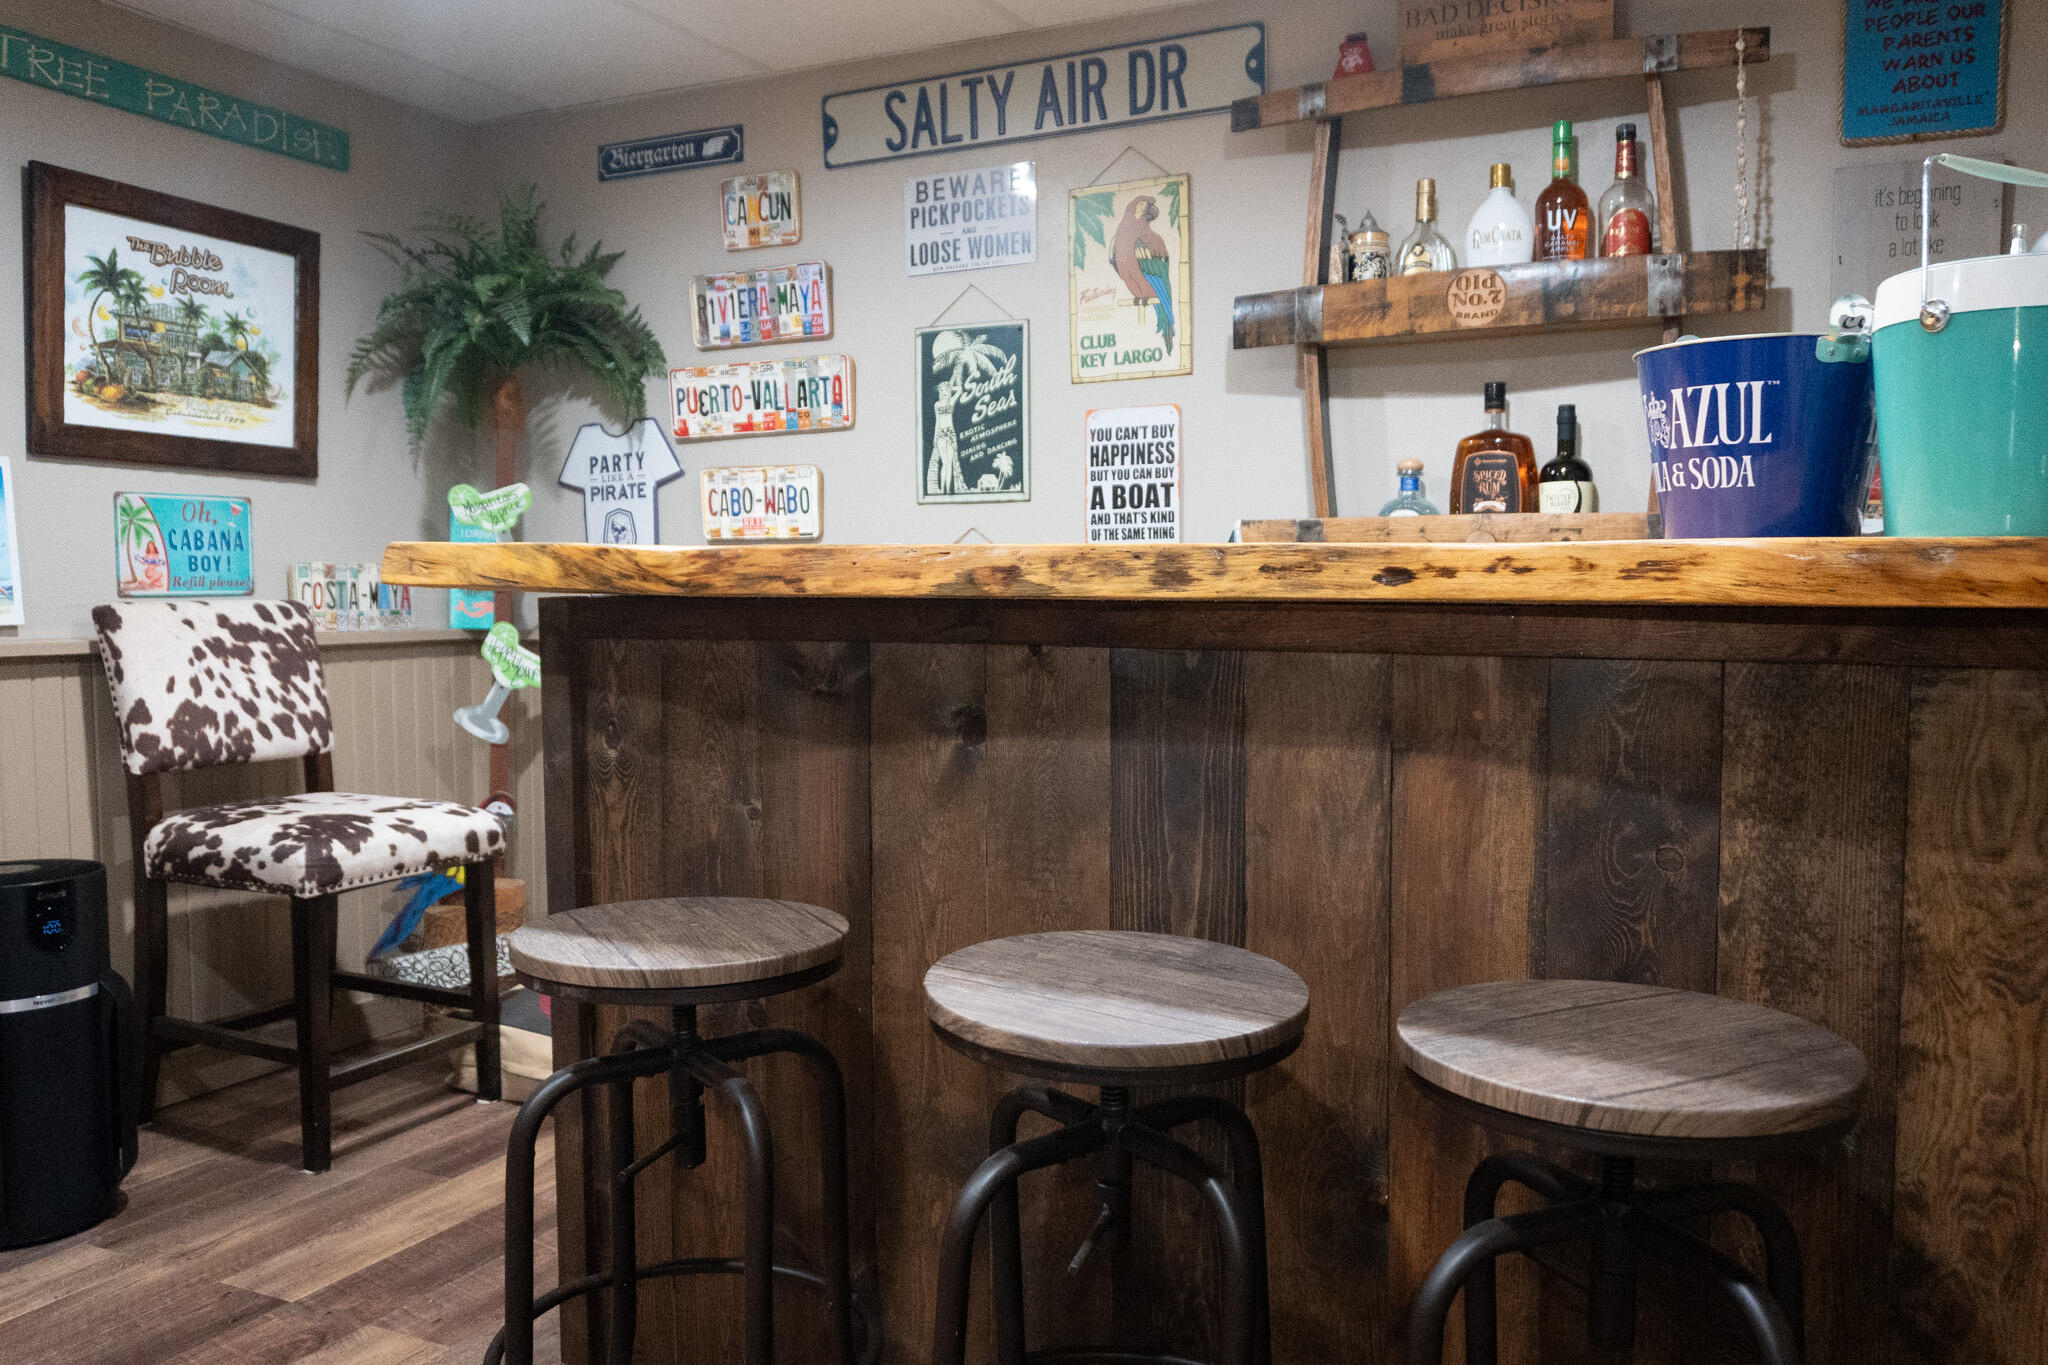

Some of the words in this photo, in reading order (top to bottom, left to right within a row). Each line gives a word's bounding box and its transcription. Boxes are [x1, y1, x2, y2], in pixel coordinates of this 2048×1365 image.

[1406, 2, 1457, 29] BAD
[1865, 8, 1940, 32] PEOPLE
[1947, 3, 1986, 21] OUR
[1883, 26, 1975, 50] PARENTS
[1883, 51, 1943, 72] WARN
[1952, 48, 1976, 64] US
[1892, 71, 1960, 95] ABOUT
[884, 70, 1015, 152] SALTY
[1035, 56, 1108, 130] AIR
[1129, 43, 1188, 116] DR
[609, 141, 694, 169] Biergarten
[915, 168, 1022, 204] BEWARE
[1874, 187, 1895, 208] it's
[1898, 183, 1961, 210] begning
[726, 191, 791, 226] CANCUN
[910, 194, 1030, 230] PICKPOCKETS
[962, 226, 977, 235] AND
[1895, 212, 1908, 231] to
[126, 236, 151, 253] The
[150, 242, 223, 272] Bubble
[910, 238, 962, 267] LOOSE
[967, 230, 1032, 261] WOMEN
[1889, 242, 1897, 258] a
[1901, 236, 1917, 256] lot
[169, 267, 234, 299] Room
[1456, 273, 1497, 291] Old
[1455, 309, 1498, 319] BRAND
[1080, 333, 1117, 350] CLUB
[1080, 352, 1108, 368] KEY
[1114, 347, 1163, 365] LARGO
[971, 389, 1018, 423] Seas
[959, 423, 986, 439] EXOTIC
[970, 419, 1017, 443] ATMOSPHERE
[1090, 427, 1112, 443] YOU
[1115, 425, 1148, 441] CAN'T
[1151, 423, 1175, 439] BUY
[960, 442, 987, 457] DINING
[970, 451, 985, 462] AND
[987, 438, 1018, 454] DANCING
[1090, 440, 1175, 468] HAPPINESS
[589, 451, 645, 475] PARTY
[1090, 469, 1109, 482] BUT
[1111, 468, 1130, 481] YOU
[1133, 467, 1153, 480] CAN
[1155, 466, 1175, 479] BUY
[1672, 462, 1687, 487] &
[1688, 454, 1755, 490] SODA
[601, 473, 624, 483] LIKE
[626, 472, 634, 481] A
[1473, 469, 1507, 483] SPICED
[590, 481, 647, 502] PIRATE
[708, 484, 809, 517] CABO-WABO
[1090, 484, 1106, 510] A
[1112, 482, 1175, 510] BOAT
[1478, 481, 1500, 497] RUM
[182, 500, 217, 525] Oh,
[1090, 513, 1111, 526] AND
[1113, 511, 1147, 525] THAT'S
[1150, 510, 1175, 524] KIND
[167, 528, 244, 551] CABANA
[1091, 528, 1103, 541] OF
[1104, 527, 1120, 541] THE
[1121, 526, 1145, 540] SAME
[1147, 526, 1175, 540] THING
[172, 575, 206, 590] Refill
[301, 581, 411, 610] COSTA-MYA
